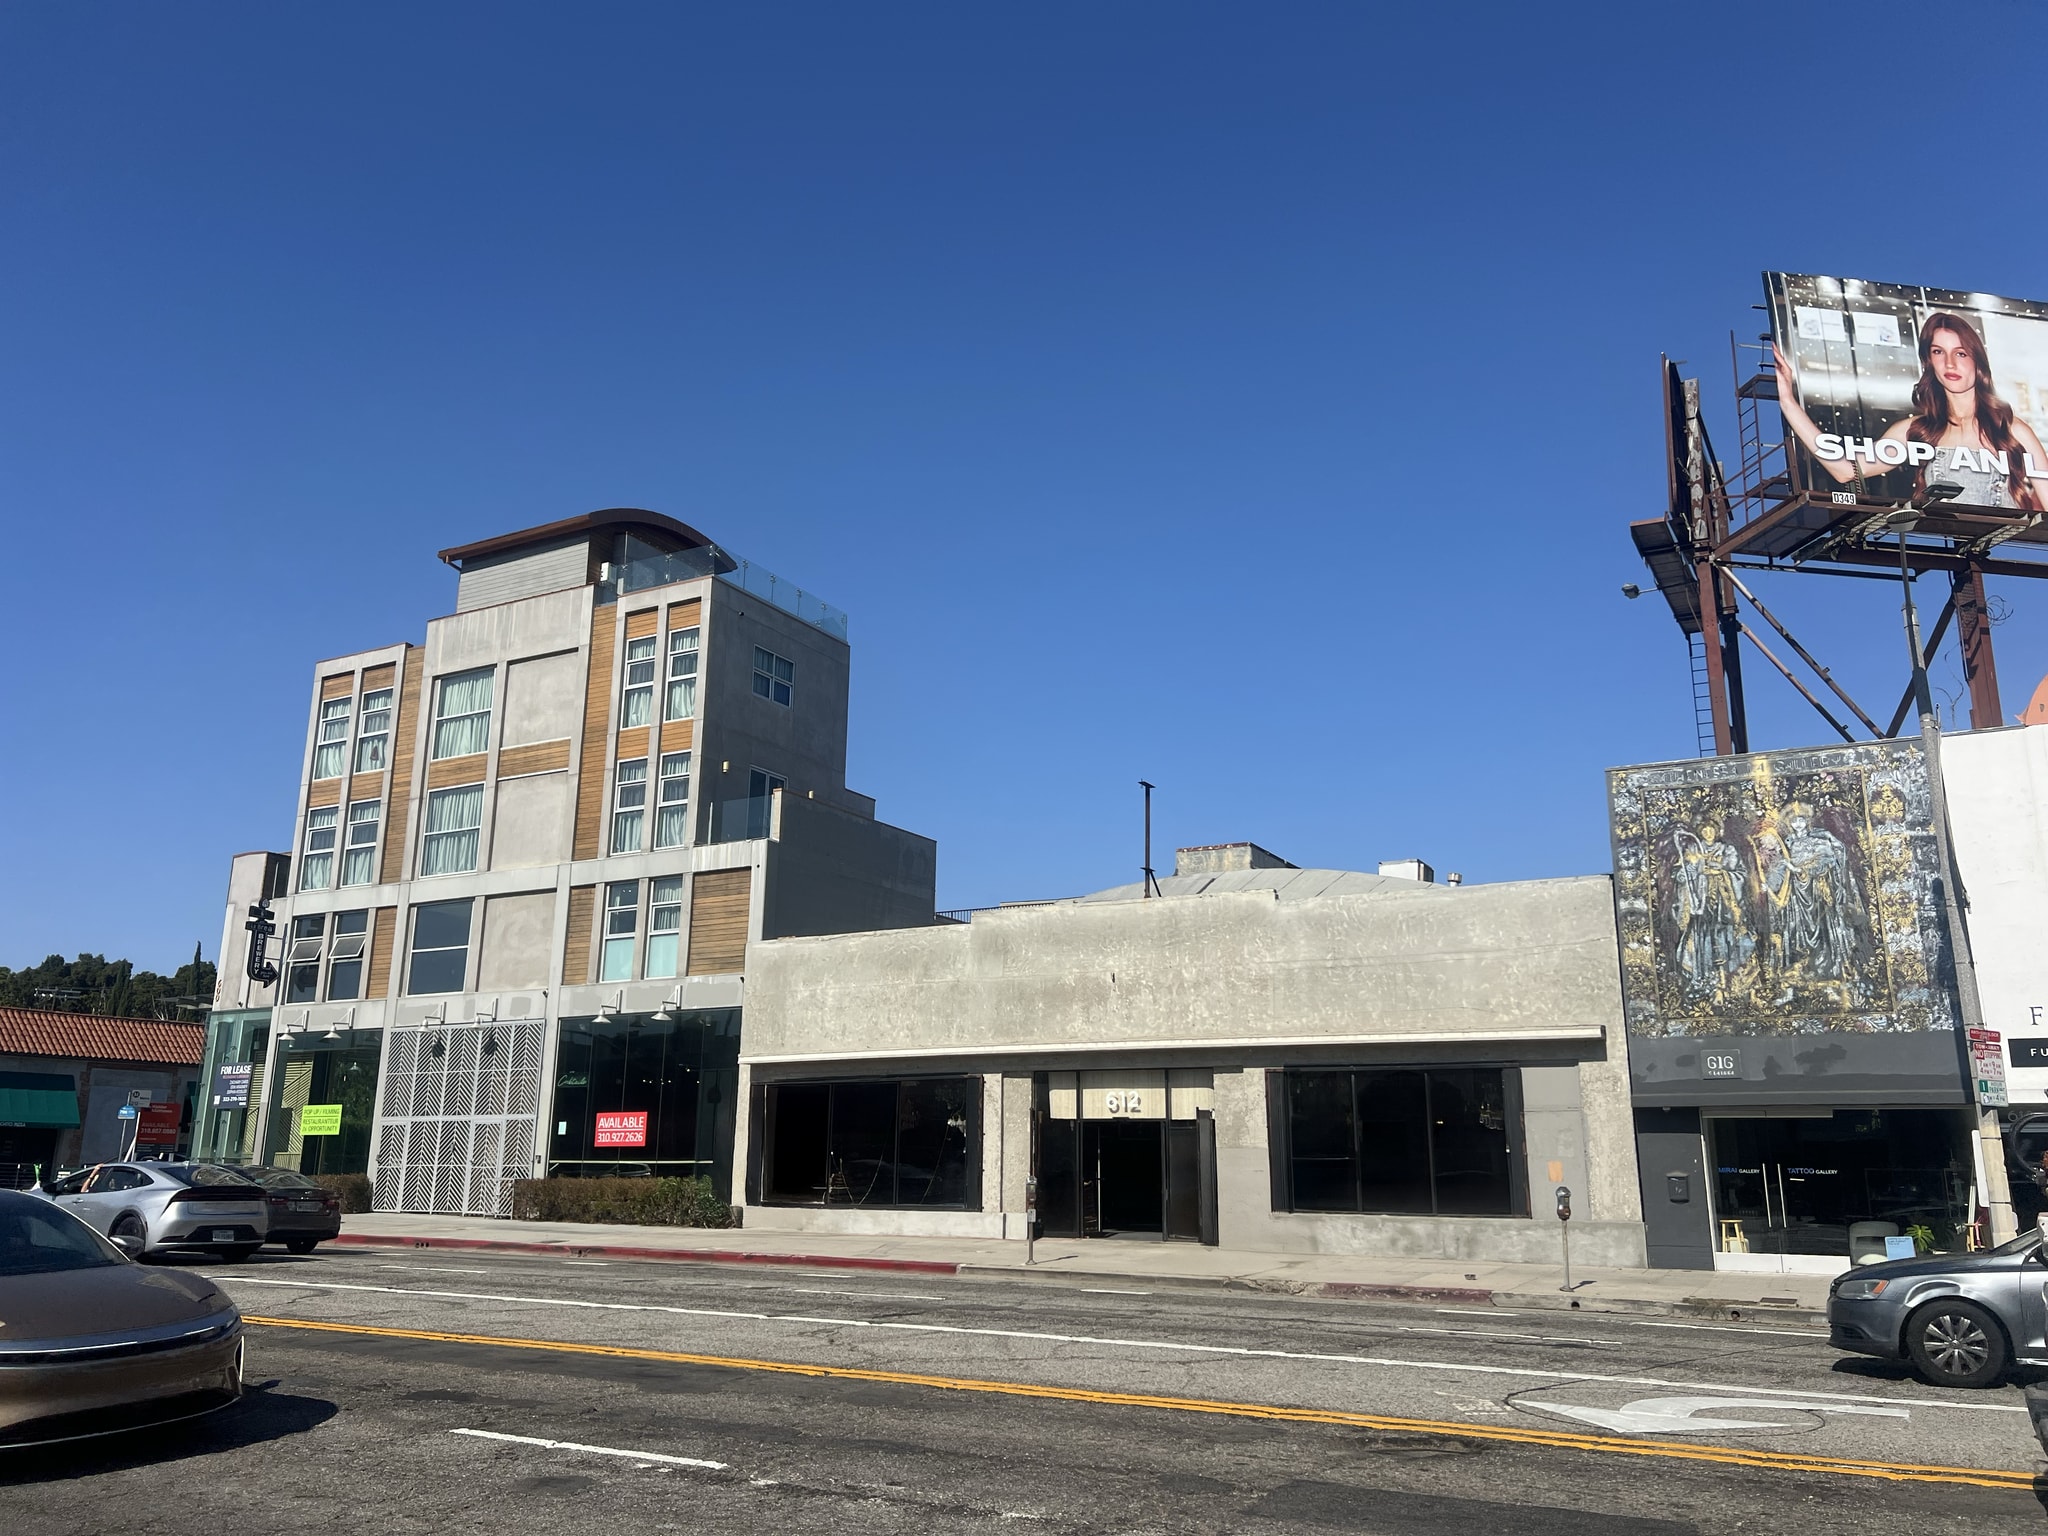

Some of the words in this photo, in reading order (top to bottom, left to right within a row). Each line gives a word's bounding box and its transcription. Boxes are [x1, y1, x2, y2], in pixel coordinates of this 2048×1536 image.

[1815, 433, 1935, 466] SHOP
[1950, 446, 2010, 475] AN
[2023, 452, 2048, 479] L
[1833, 493, 1855, 504] D349
[254, 933, 265, 974] BREWERY
[1976, 1050, 1984, 1058] NO
[220, 1066, 232, 1075] FOR
[233, 1065, 252, 1074] LEASE
[1106, 1090, 1139, 1109] 612
[598, 1116, 645, 1128] AVAILABLE
[597, 1132, 643, 1143] 310.927.2626
